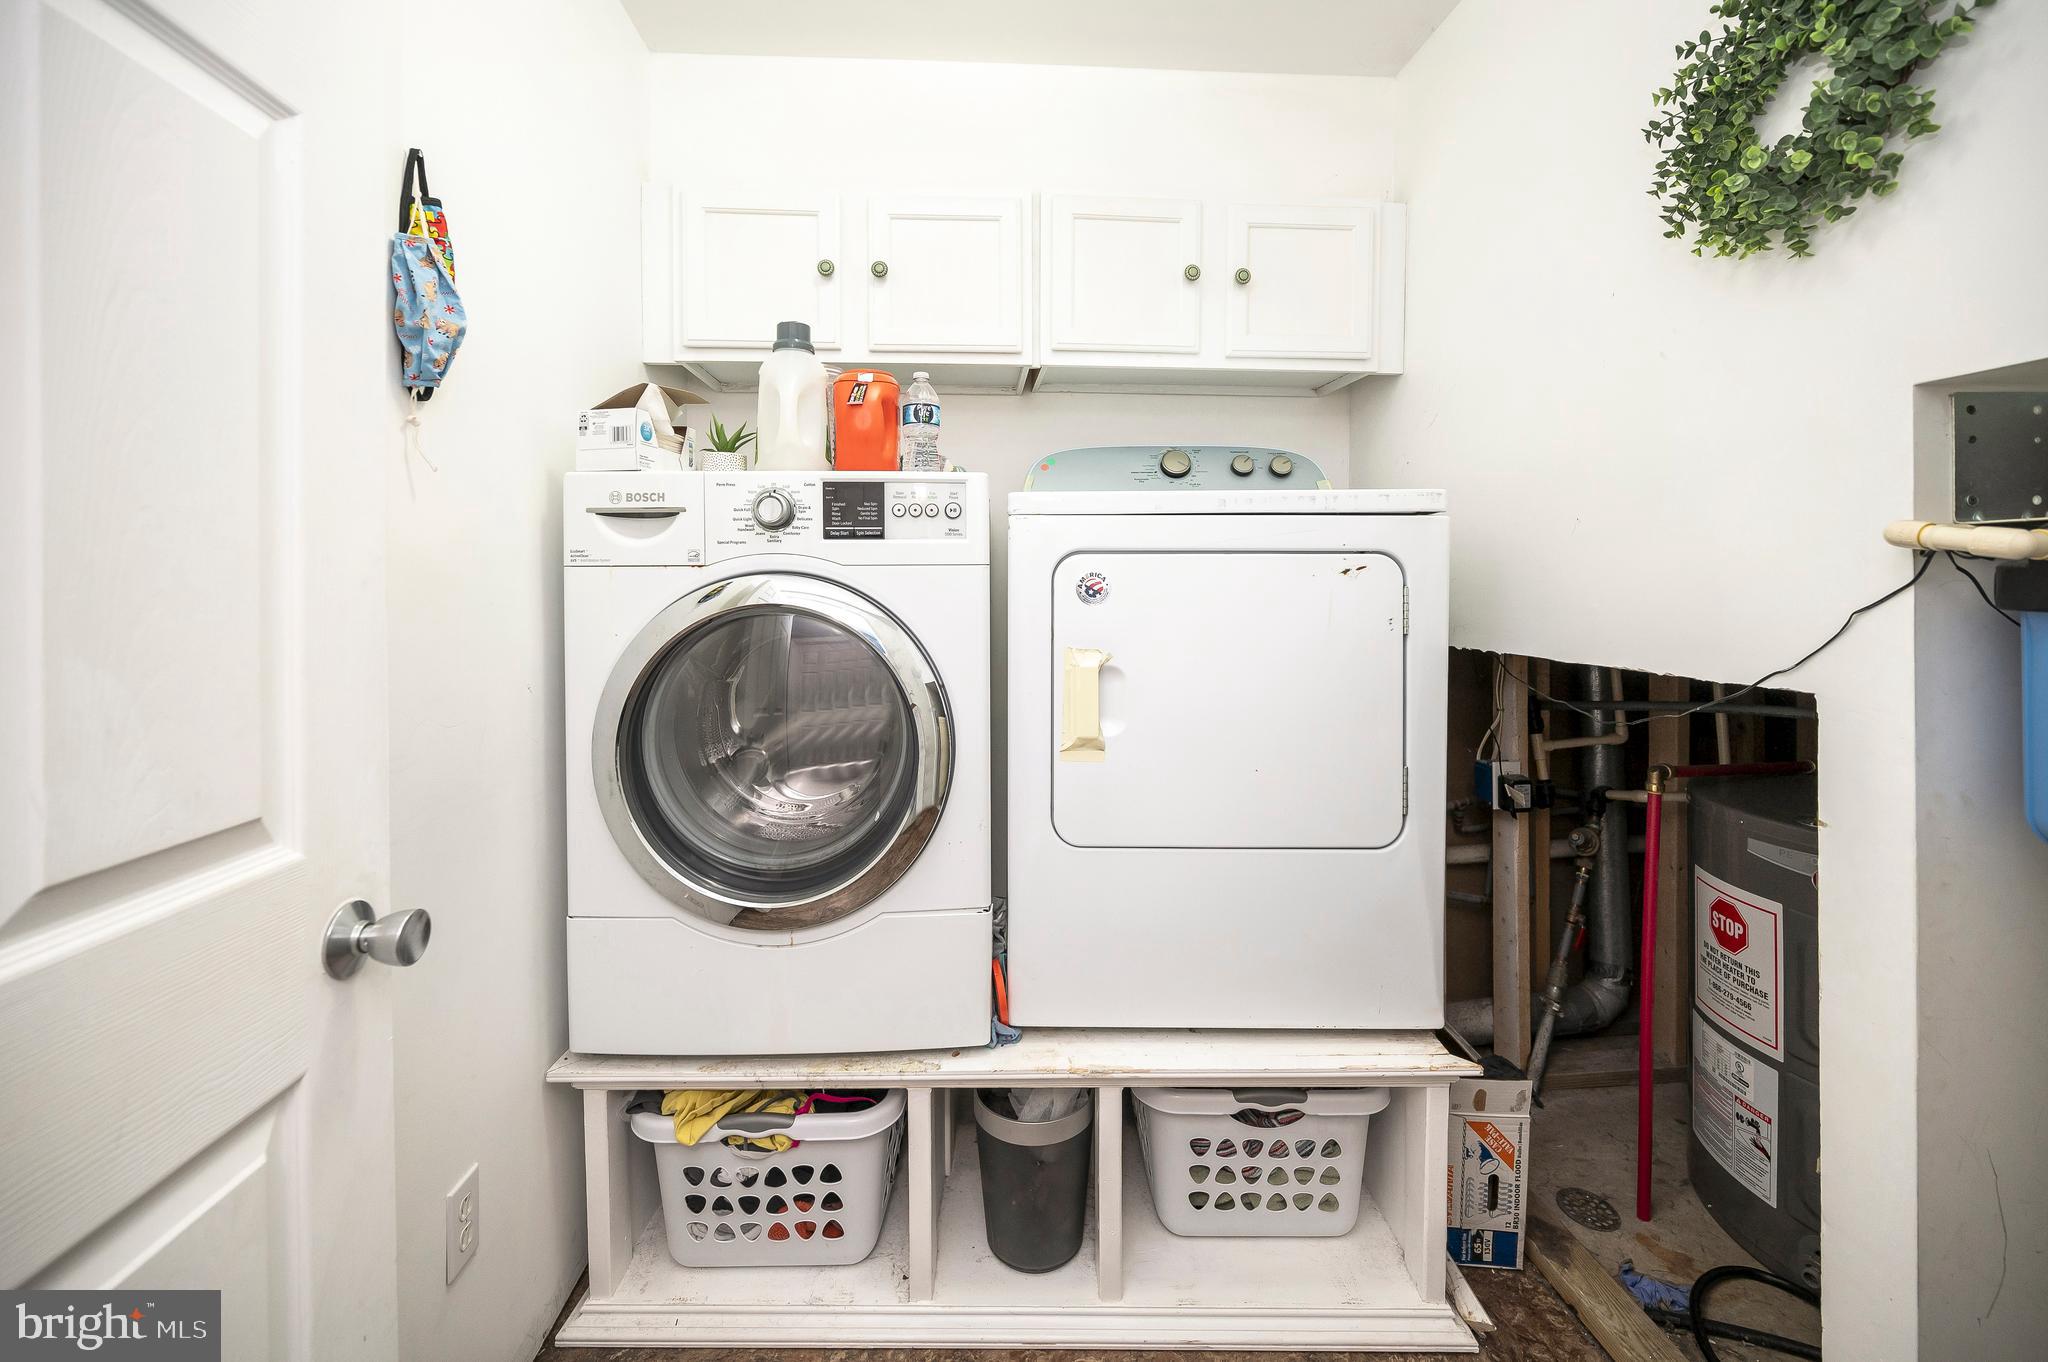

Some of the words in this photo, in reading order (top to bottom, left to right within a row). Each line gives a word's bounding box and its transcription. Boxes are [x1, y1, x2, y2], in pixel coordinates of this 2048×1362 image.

[626, 493, 665, 502] BOSCH
[1078, 572, 1106, 589] AMERICA
[1712, 911, 1744, 940] STOP
[1704, 940, 1709, 949] DO
[1710, 944, 1719, 957] NOT
[1720, 952, 1742, 970] RETURN
[1744, 965, 1760, 979] THIS
[1706, 950, 1721, 966] WATER
[1722, 962, 1745, 980] HEATER
[1747, 975, 1756, 985] TO
[1708, 960, 1722, 976] PLACE
[1724, 971, 1731, 980] OF
[1733, 977, 1768, 1000] PURCHASE
[1742, 1102, 1770, 1122] DANGER
[1484, 1123, 1514, 1154] VALU-PAK
[1485, 1135, 1503, 1153] CASE
[1474, 1243, 1481, 1253] 65
